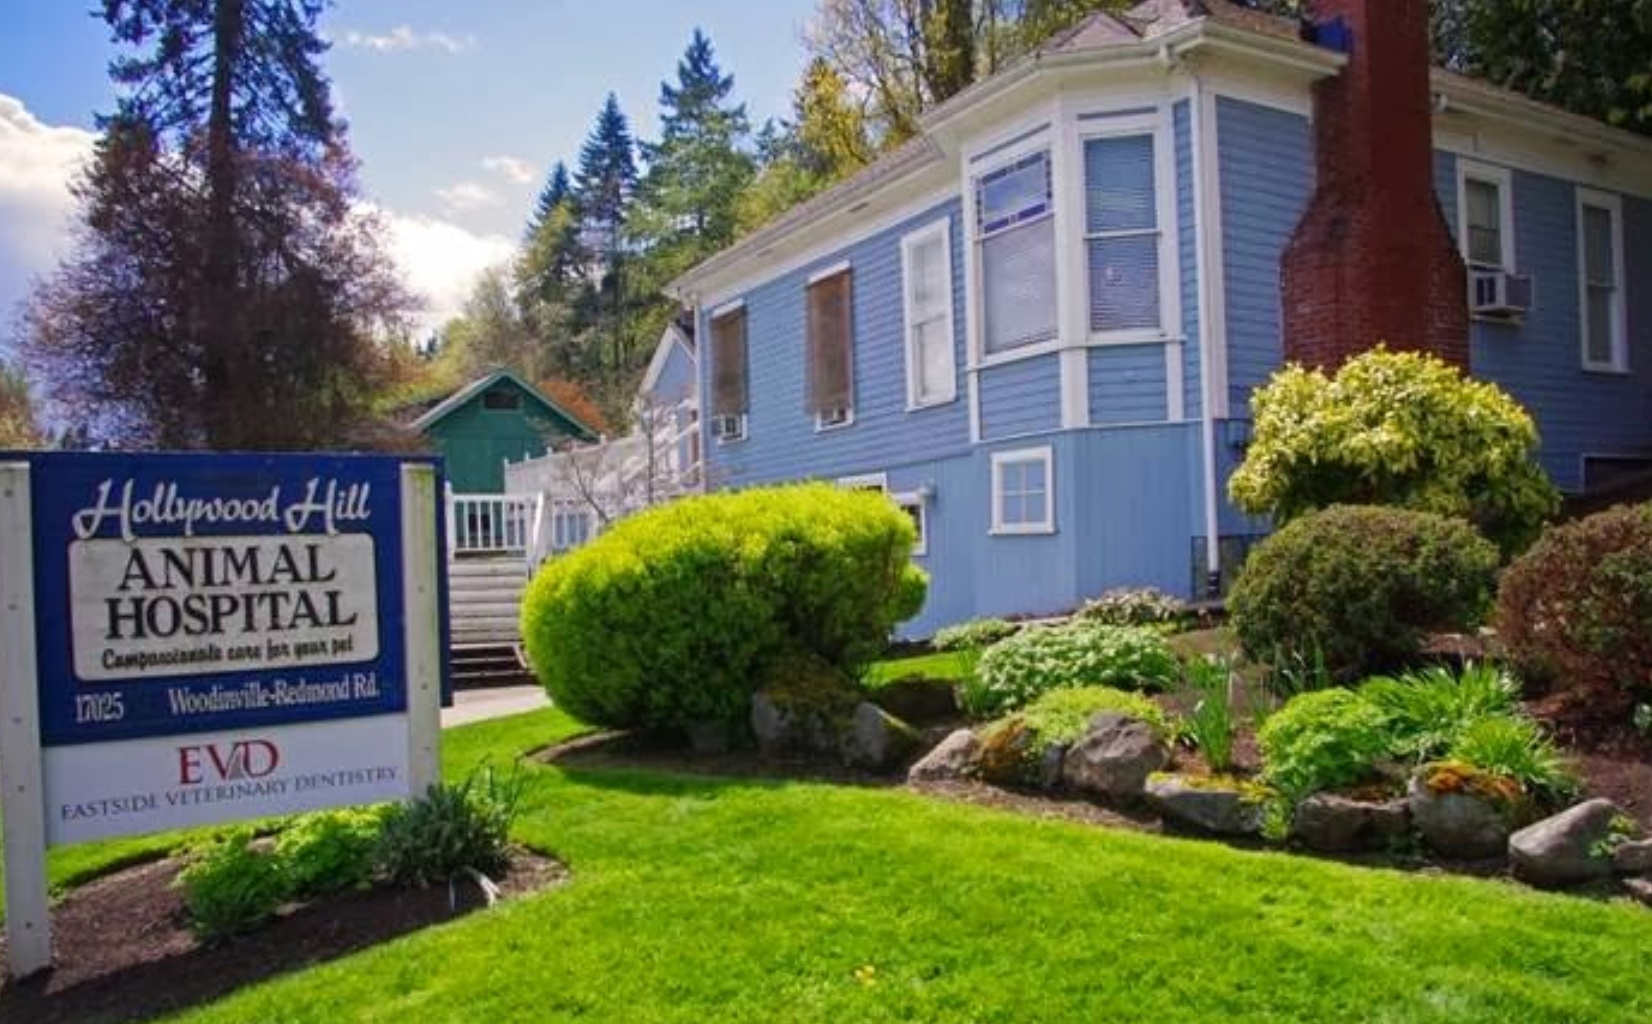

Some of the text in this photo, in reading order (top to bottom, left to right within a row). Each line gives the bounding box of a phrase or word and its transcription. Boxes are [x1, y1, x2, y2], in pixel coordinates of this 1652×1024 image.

[72, 476, 371, 543] Hollywood Hill
[117, 543, 336, 591] ANIMAL
[103, 590, 358, 640] HOSPITAL
[228, 645, 261, 661] care
[266, 639, 290, 660] for
[293, 640, 328, 660] your
[331, 634, 353, 655] pet
[76, 671, 380, 723] 17025 Woodinville-Redmond Rd.
[177, 739, 279, 785] EVD
[61, 766, 399, 820] EASTSIDE VETERINARY DENTISTRY
